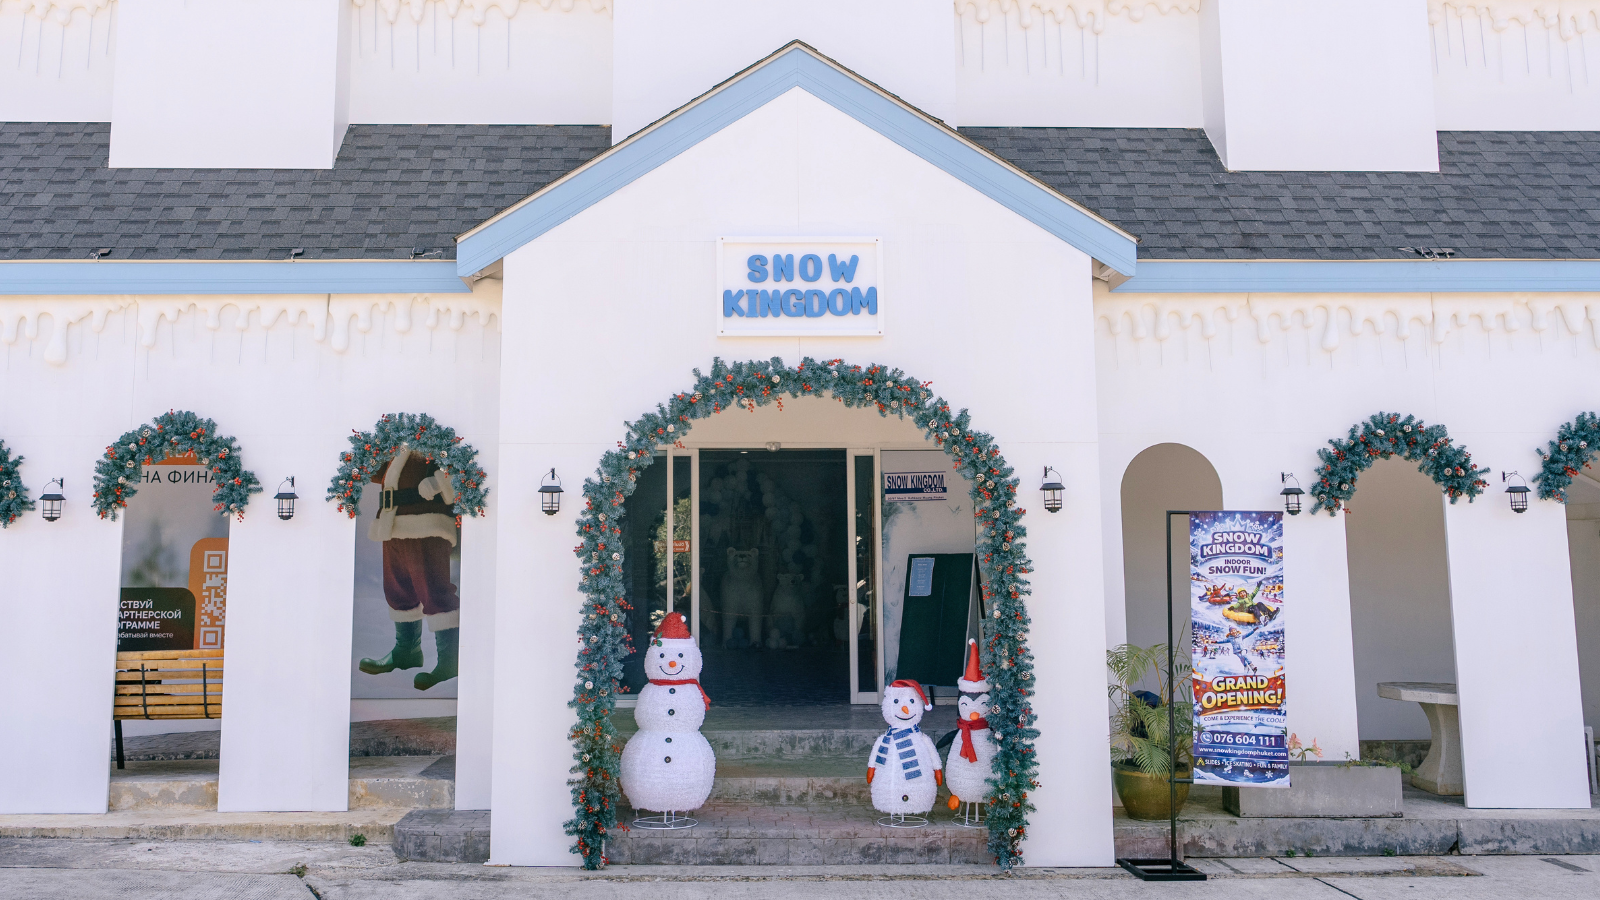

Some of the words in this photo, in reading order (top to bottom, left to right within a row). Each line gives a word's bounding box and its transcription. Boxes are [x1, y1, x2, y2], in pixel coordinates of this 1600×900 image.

[747, 253, 859, 283] SNOW
[723, 286, 878, 318] KINGDOM
[887, 475, 908, 489] SNOW
[910, 474, 944, 488] KINGDOM
[1213, 532, 1260, 543] SNOW
[1203, 544, 1268, 556] KINGDOM
[1208, 566, 1240, 574] SNOW
[1243, 566, 1267, 575] FUN!
[119, 599, 153, 609] СТВУЙ
[1212, 676, 1268, 691] GRAND
[1202, 688, 1283, 709] OPENING!
[1213, 733, 1233, 743] 076
[1235, 734, 1256, 744] 604
[1259, 736, 1275, 746] 111
[1199, 747, 1287, 757] www.snowkingdomphuket.com
